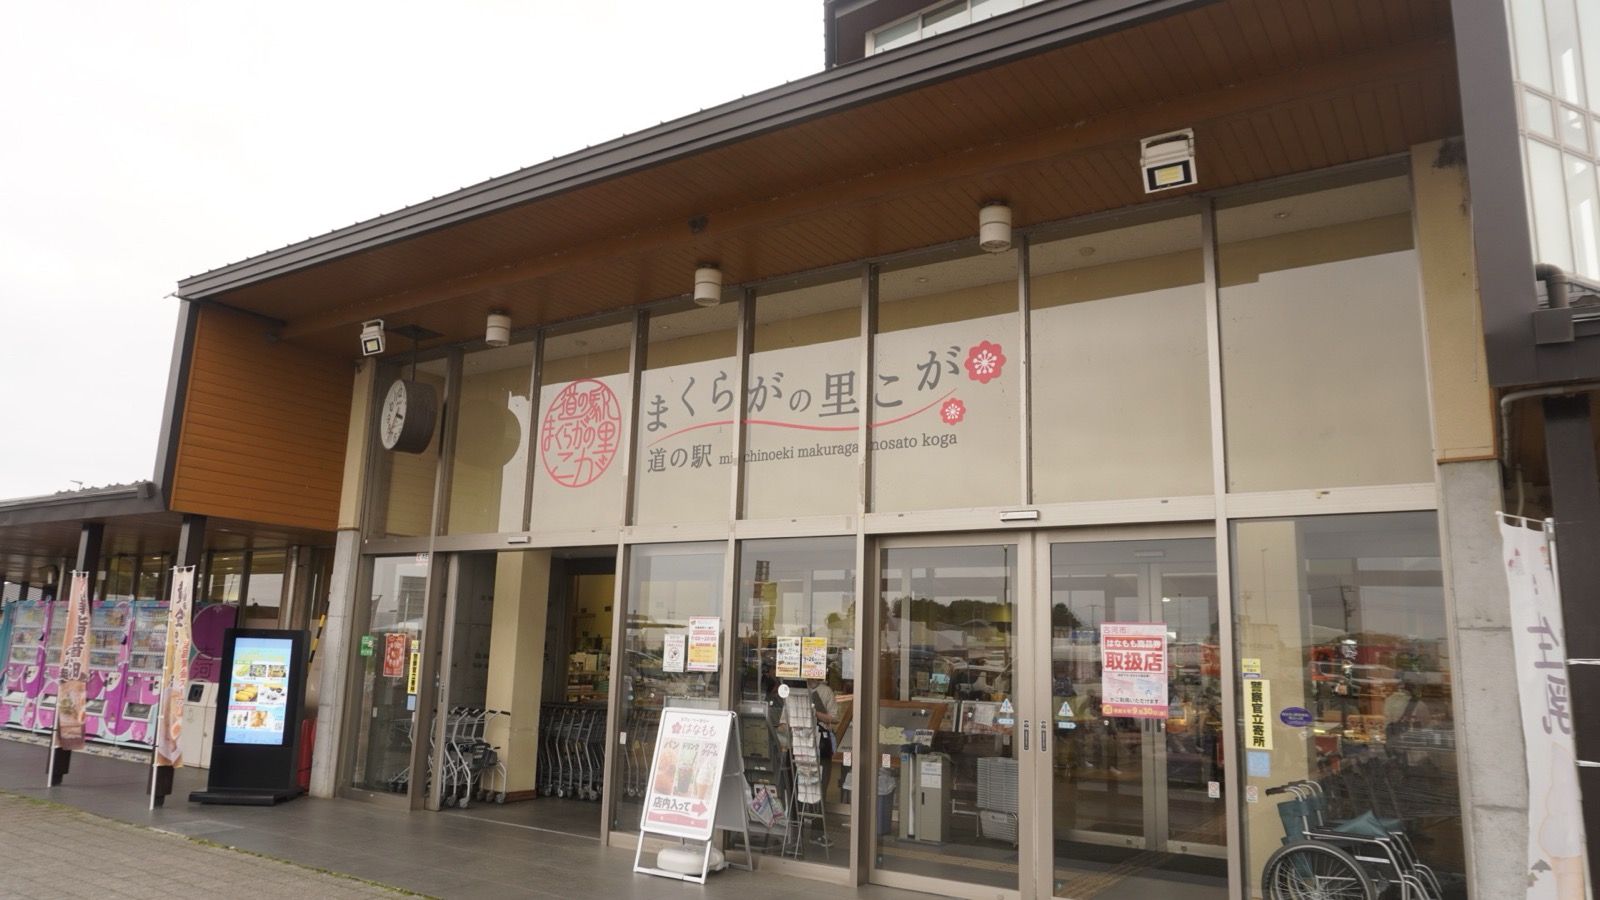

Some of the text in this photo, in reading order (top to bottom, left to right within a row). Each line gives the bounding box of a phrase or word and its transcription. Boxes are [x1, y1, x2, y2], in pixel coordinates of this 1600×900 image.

[646, 345, 961, 432] まくらがの里こが
[647, 444, 712, 473] 道の駅
[719, 446, 794, 465] michinoeki
[922, 433, 958, 448] koga
[1106, 639, 1161, 649] はなもも商品券
[1105, 652, 1162, 671] 取扱店
[1250, 681, 1265, 747] 警察官立寄所
[682, 724, 717, 737] はなもも
[663, 740, 680, 750] パン
[682, 742, 700, 750] ドリンク
[701, 749, 718, 757] クリーム
[653, 797, 692, 813] 店内入って
